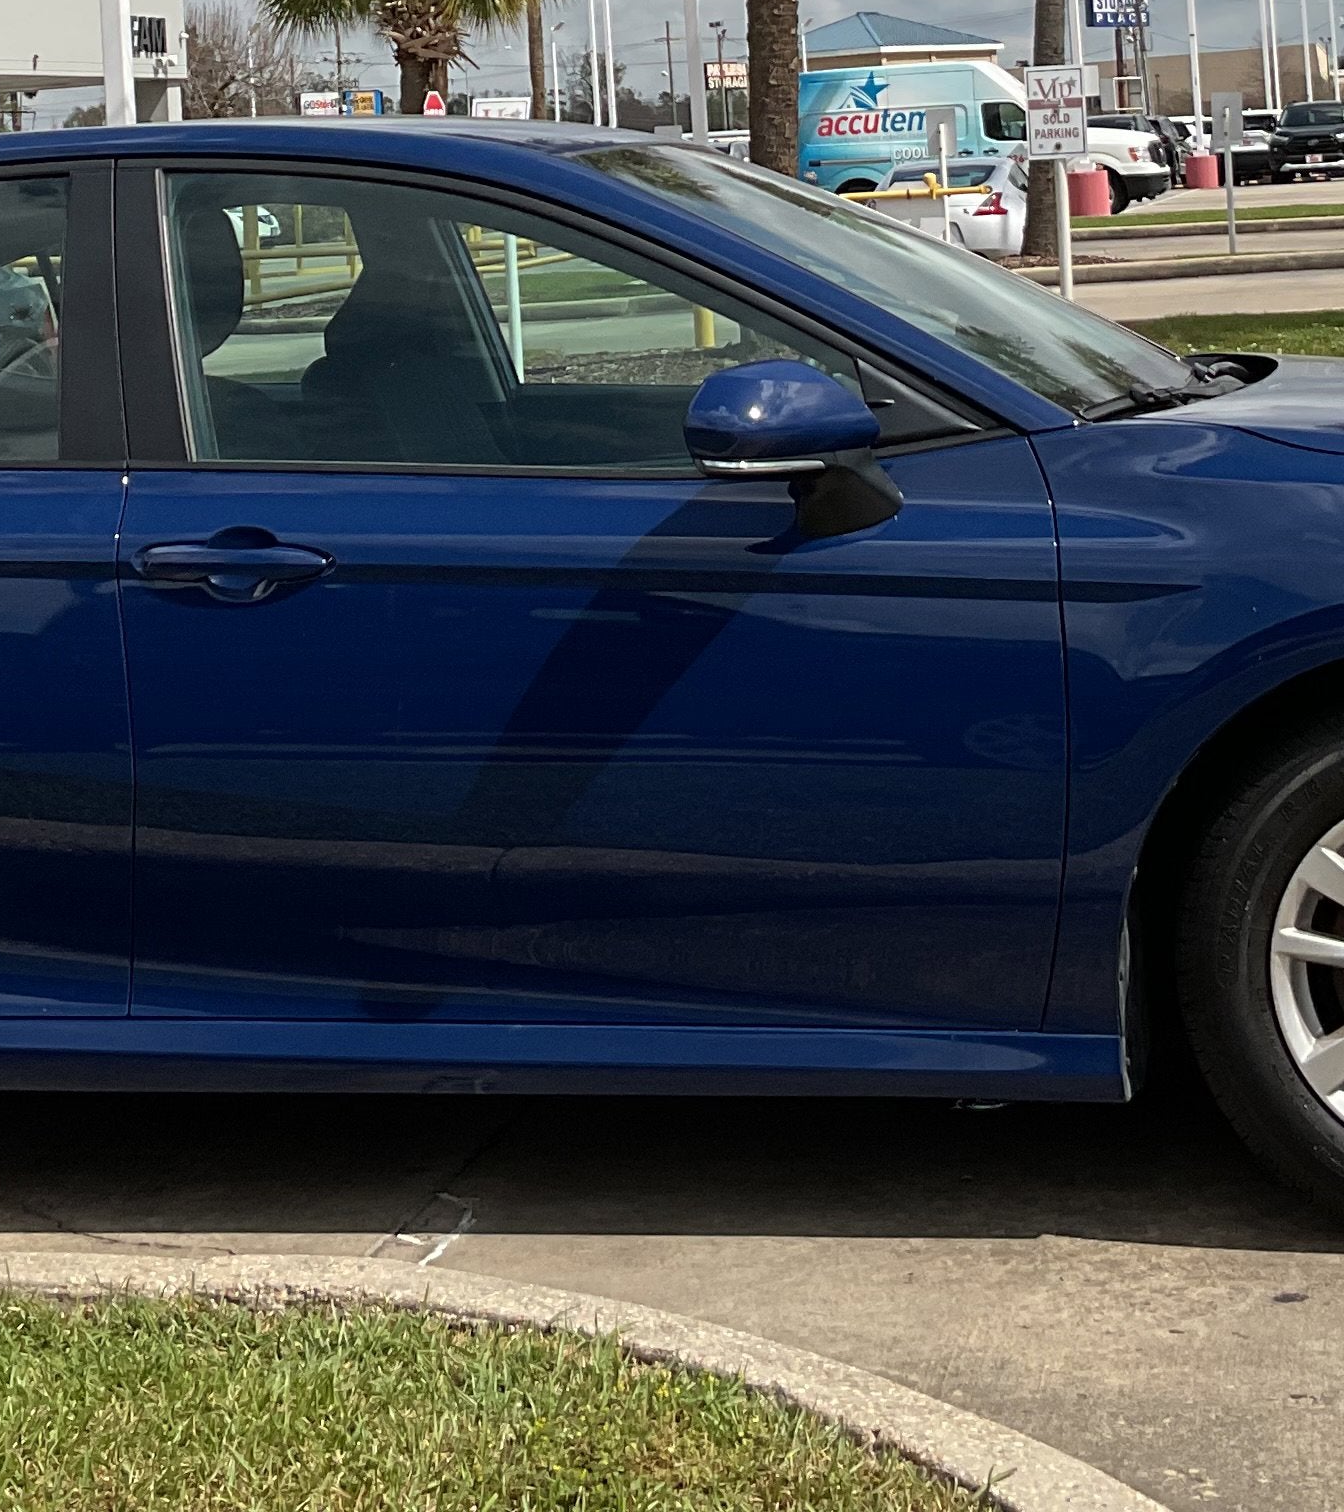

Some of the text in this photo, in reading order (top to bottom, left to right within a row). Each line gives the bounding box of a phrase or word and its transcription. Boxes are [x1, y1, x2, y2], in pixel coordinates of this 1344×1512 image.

[1096, 13, 1148, 24] PLACE
[708, 76, 748, 88] STORAG
[1042, 112, 1071, 125] SOLD
[1034, 127, 1080, 140] PARKING
[893, 146, 932, 160] COOL
